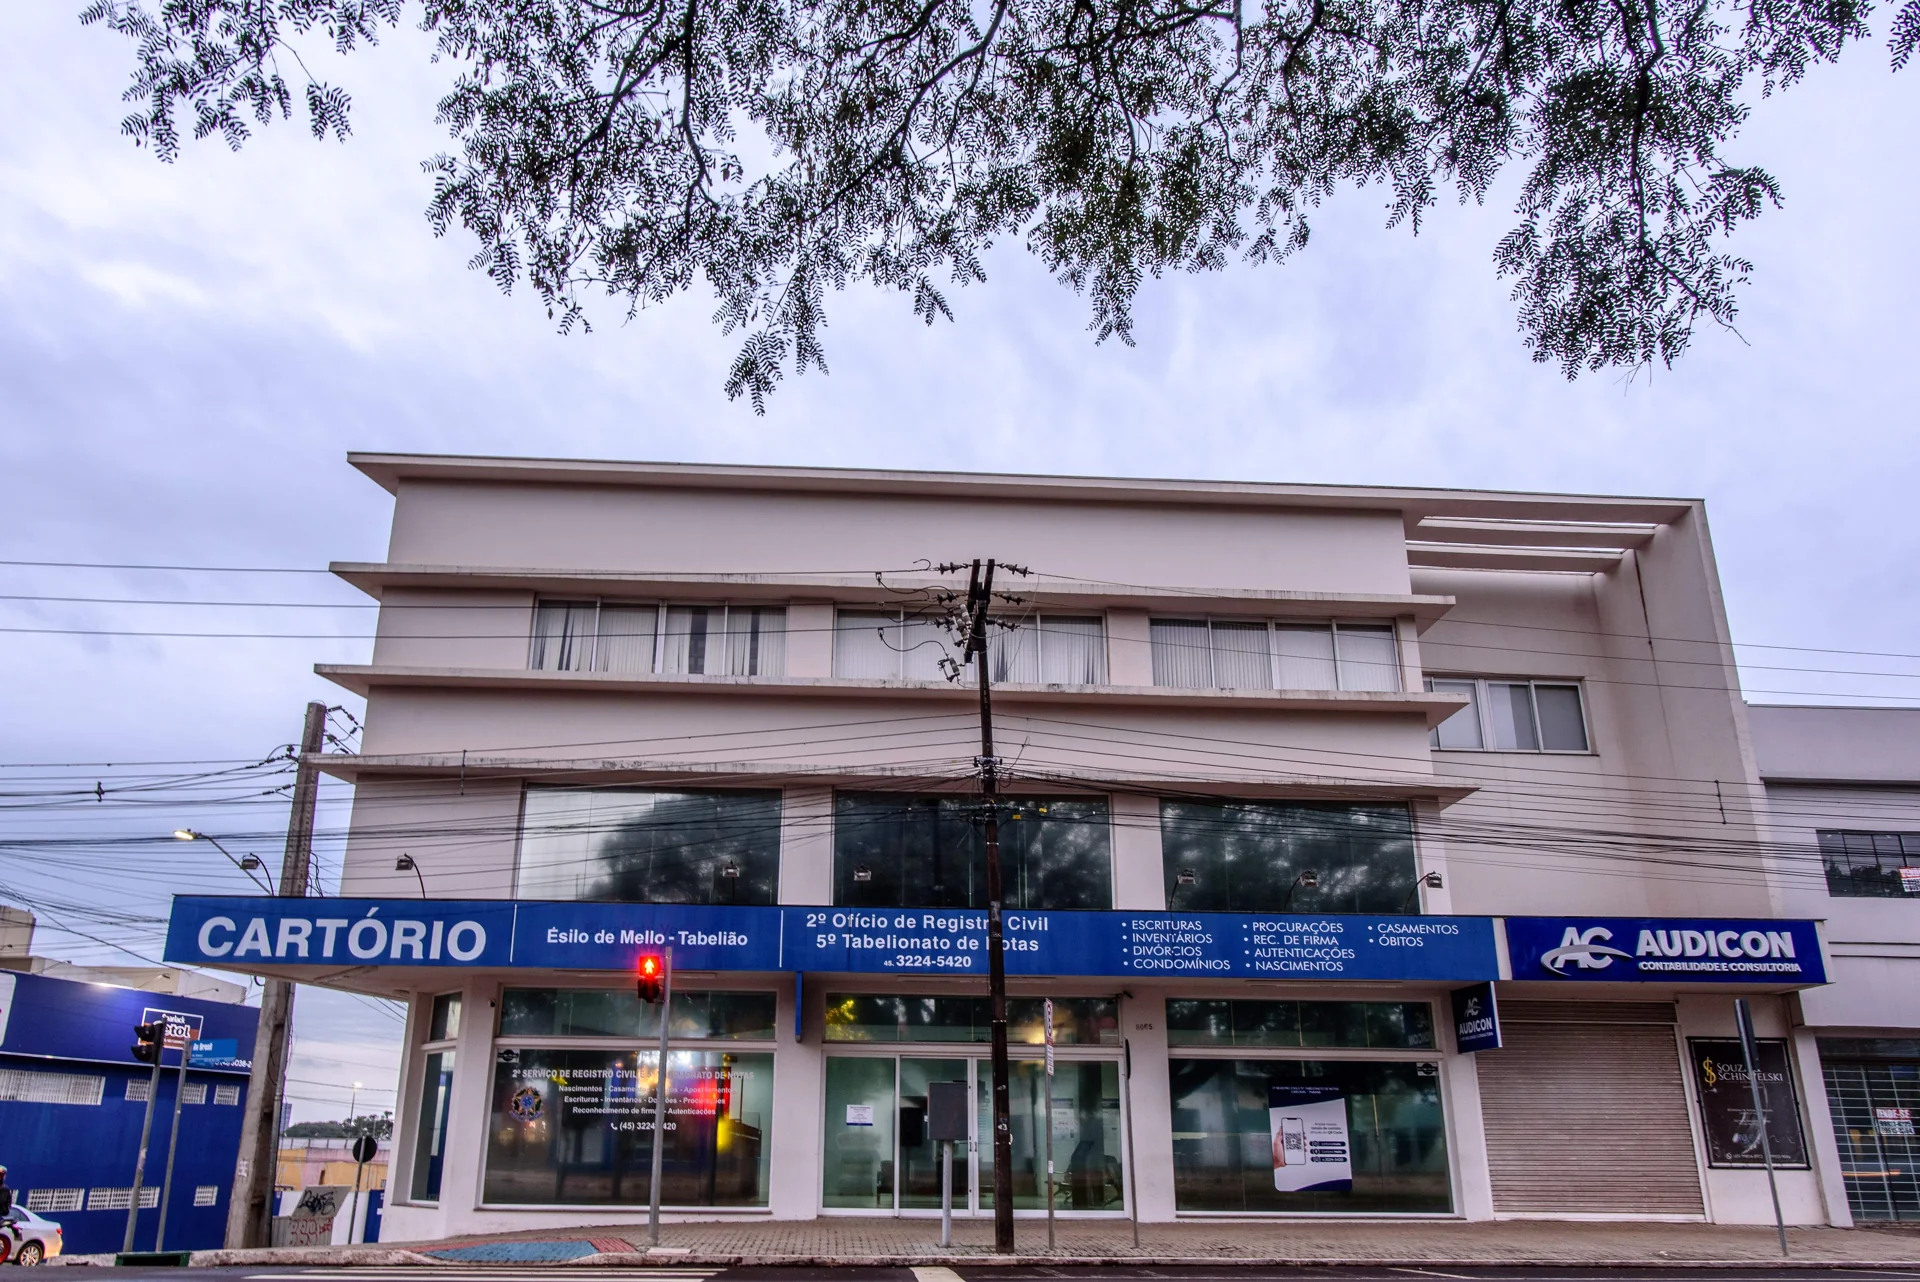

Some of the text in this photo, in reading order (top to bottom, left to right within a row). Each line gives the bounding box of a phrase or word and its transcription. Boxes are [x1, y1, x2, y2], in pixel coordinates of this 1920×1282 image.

[832, 913, 888, 929] Ofício
[894, 914, 916, 929] de
[923, 915, 989, 932] Registr
[1007, 916, 1048, 931] Civil
[1131, 920, 1203, 931] ESCRITURAS
[1252, 921, 1345, 935] PROCURAÇÕES
[1377, 923, 1459, 935] CASAMENTOS
[198, 906, 487, 961] CARTÓRIO
[594, 929, 615, 944] de
[620, 929, 665, 945] Mello
[678, 930, 748, 946] Tabelião
[1132, 931, 1213, 944] INVENTÁRIOS
[841, 933, 951, 950] Tabelionato
[956, 936, 979, 950] de
[1253, 935, 1340, 946] REC. DE FIRMA
[1379, 934, 1424, 948] ÓBITOS
[1635, 929, 1796, 959] AUDICON
[1133, 944, 1203, 957] DIVÓRCIOS
[1254, 946, 1356, 961] AUTENTICAÇÕES
[1553, 926, 1614, 969] AC
[896, 954, 972, 968] 3224-5420
[1133, 957, 1231, 970] CONDOMÍNIOS
[1255, 961, 1345, 972] NASCIMENTOS
[1638, 960, 1719, 971] CONTABILIDADE
[1729, 962, 1802, 972] CONSULTORIA
[1459, 1017, 1493, 1035] AUDICON
[1716, 1063, 1747, 1072] SOUZ
[522, 1070, 557, 1079] SERVIÇO
[559, 1070, 570, 1078] DE
[572, 1070, 613, 1078] REGISTRO
[616, 1070, 637, 1079] CIVIL
[714, 1071, 725, 1080] DE
[1718, 1072, 1784, 1081] SCHINELSKI
[558, 1085, 602, 1093] Nascimentos
[572, 1106, 629, 1114] Reconhecimento
[619, 1122, 677, 1131] (45) 3224420
